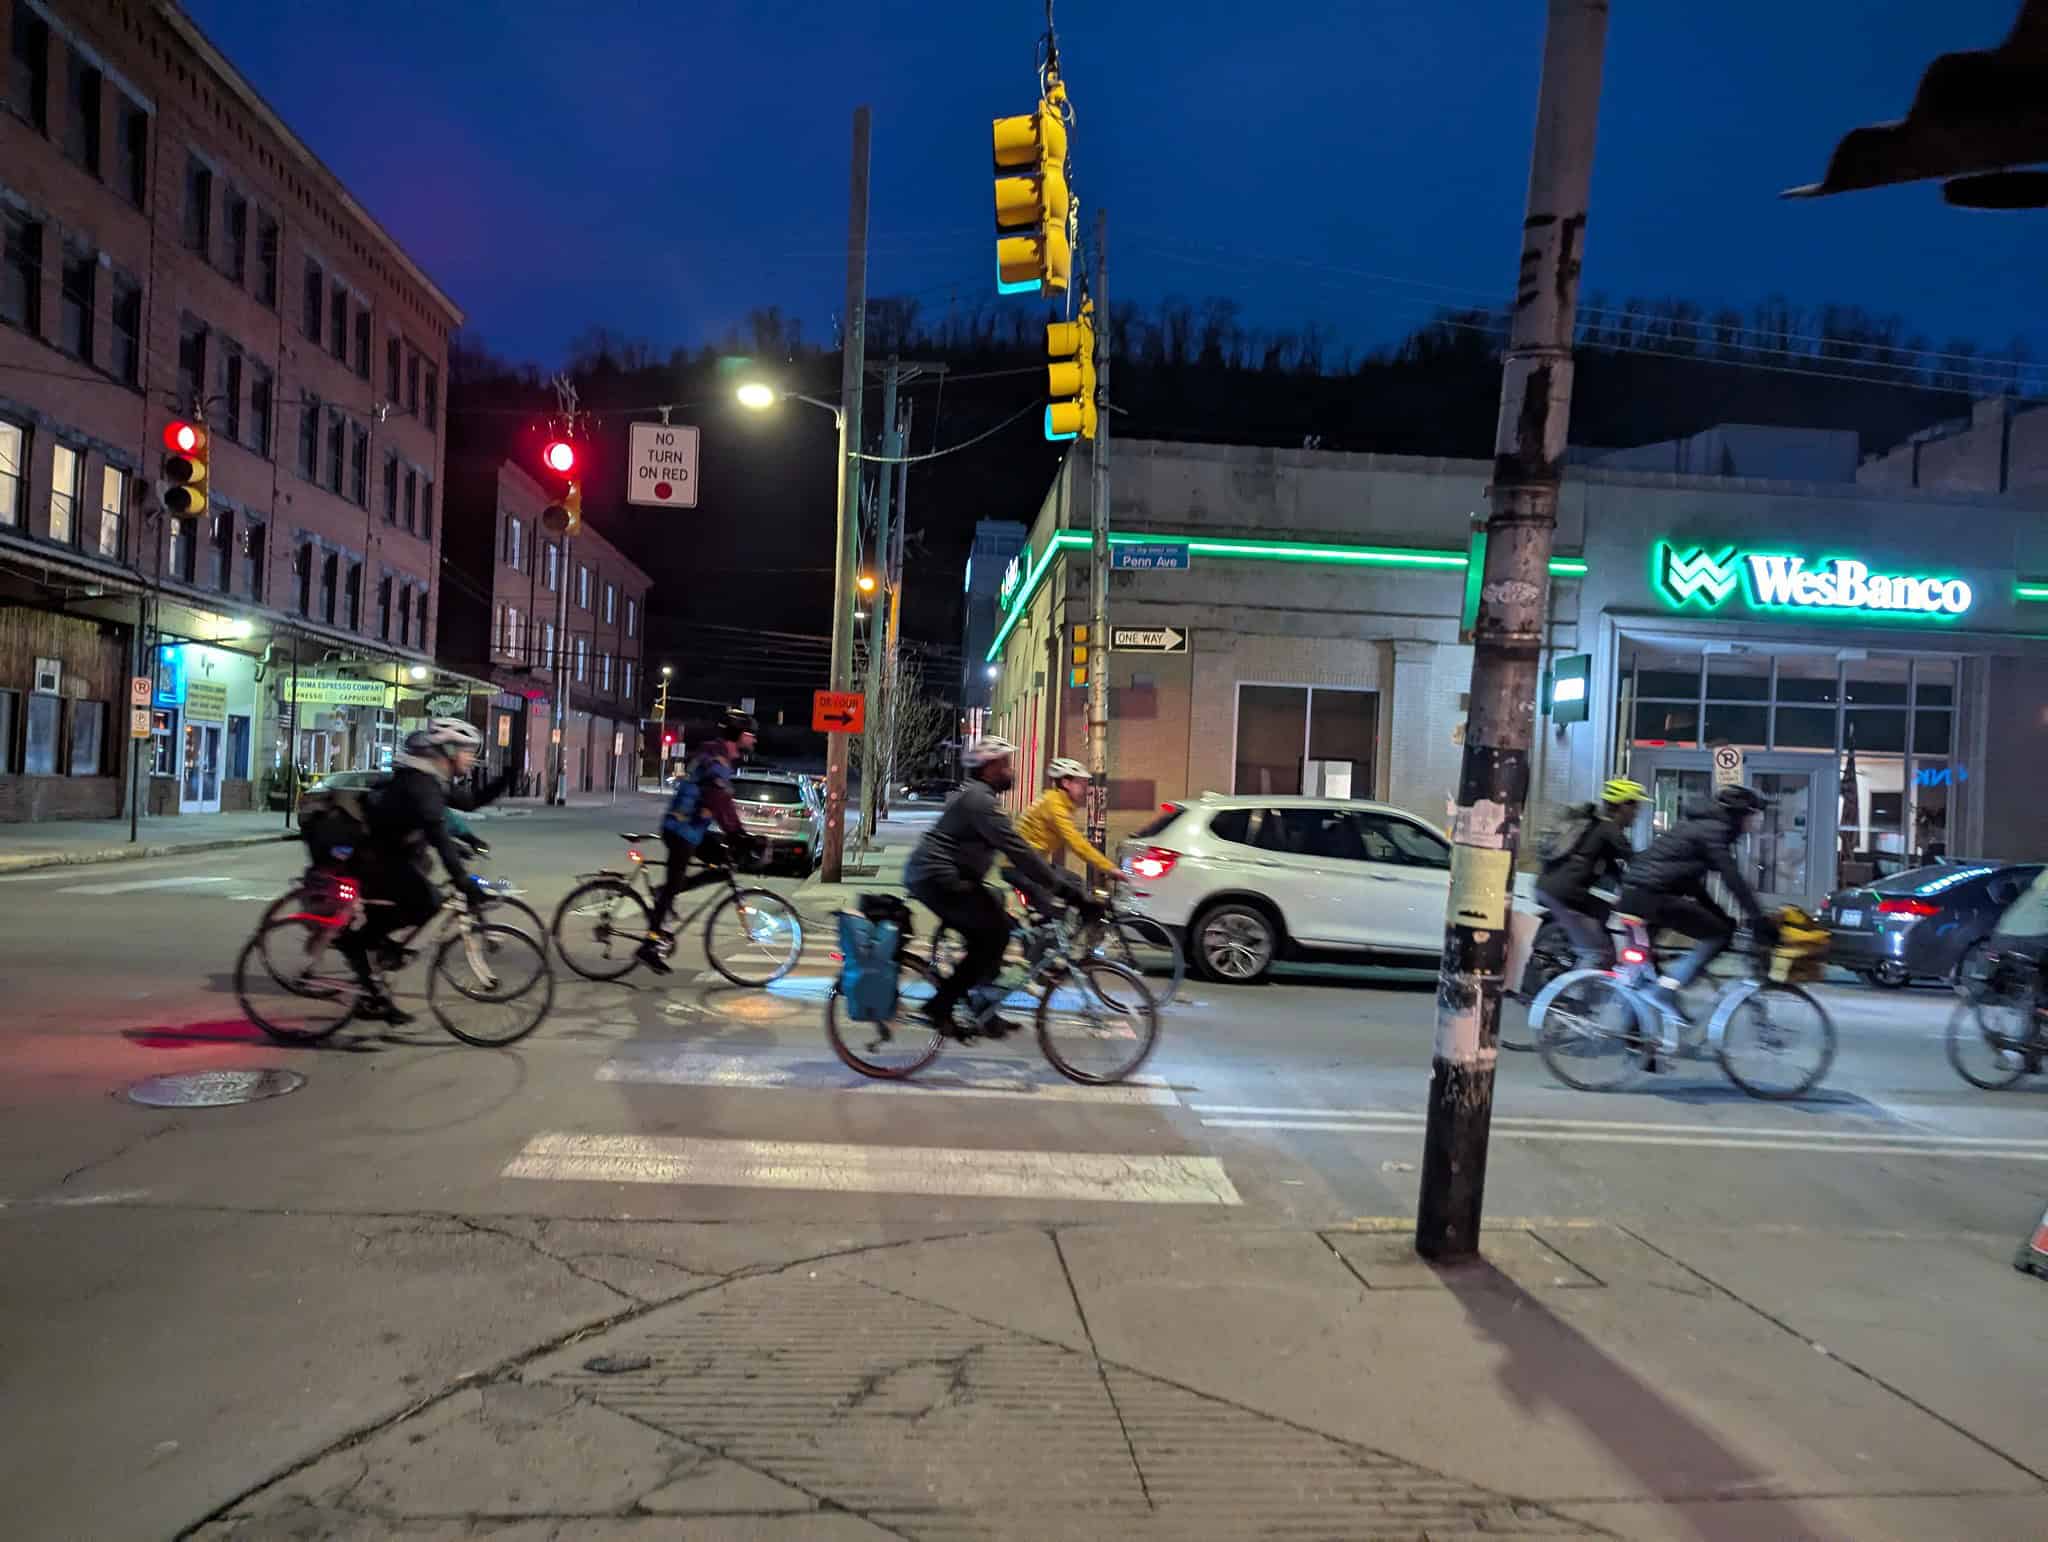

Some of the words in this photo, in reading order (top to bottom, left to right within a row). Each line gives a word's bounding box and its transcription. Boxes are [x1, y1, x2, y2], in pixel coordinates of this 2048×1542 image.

[655, 431, 675, 446] NO
[647, 448, 683, 464] TURN
[639, 465, 658, 479] ON
[662, 467, 688, 481] RED
[1123, 555, 1152, 568] Penn
[1157, 555, 1177, 568] Ave
[1746, 554, 1972, 614] WesBanco
[1119, 631, 1137, 645] ONE
[1142, 631, 1164, 645] WAY
[317, 682, 352, 690] ESPRESSO
[352, 683, 384, 691] COMPANY
